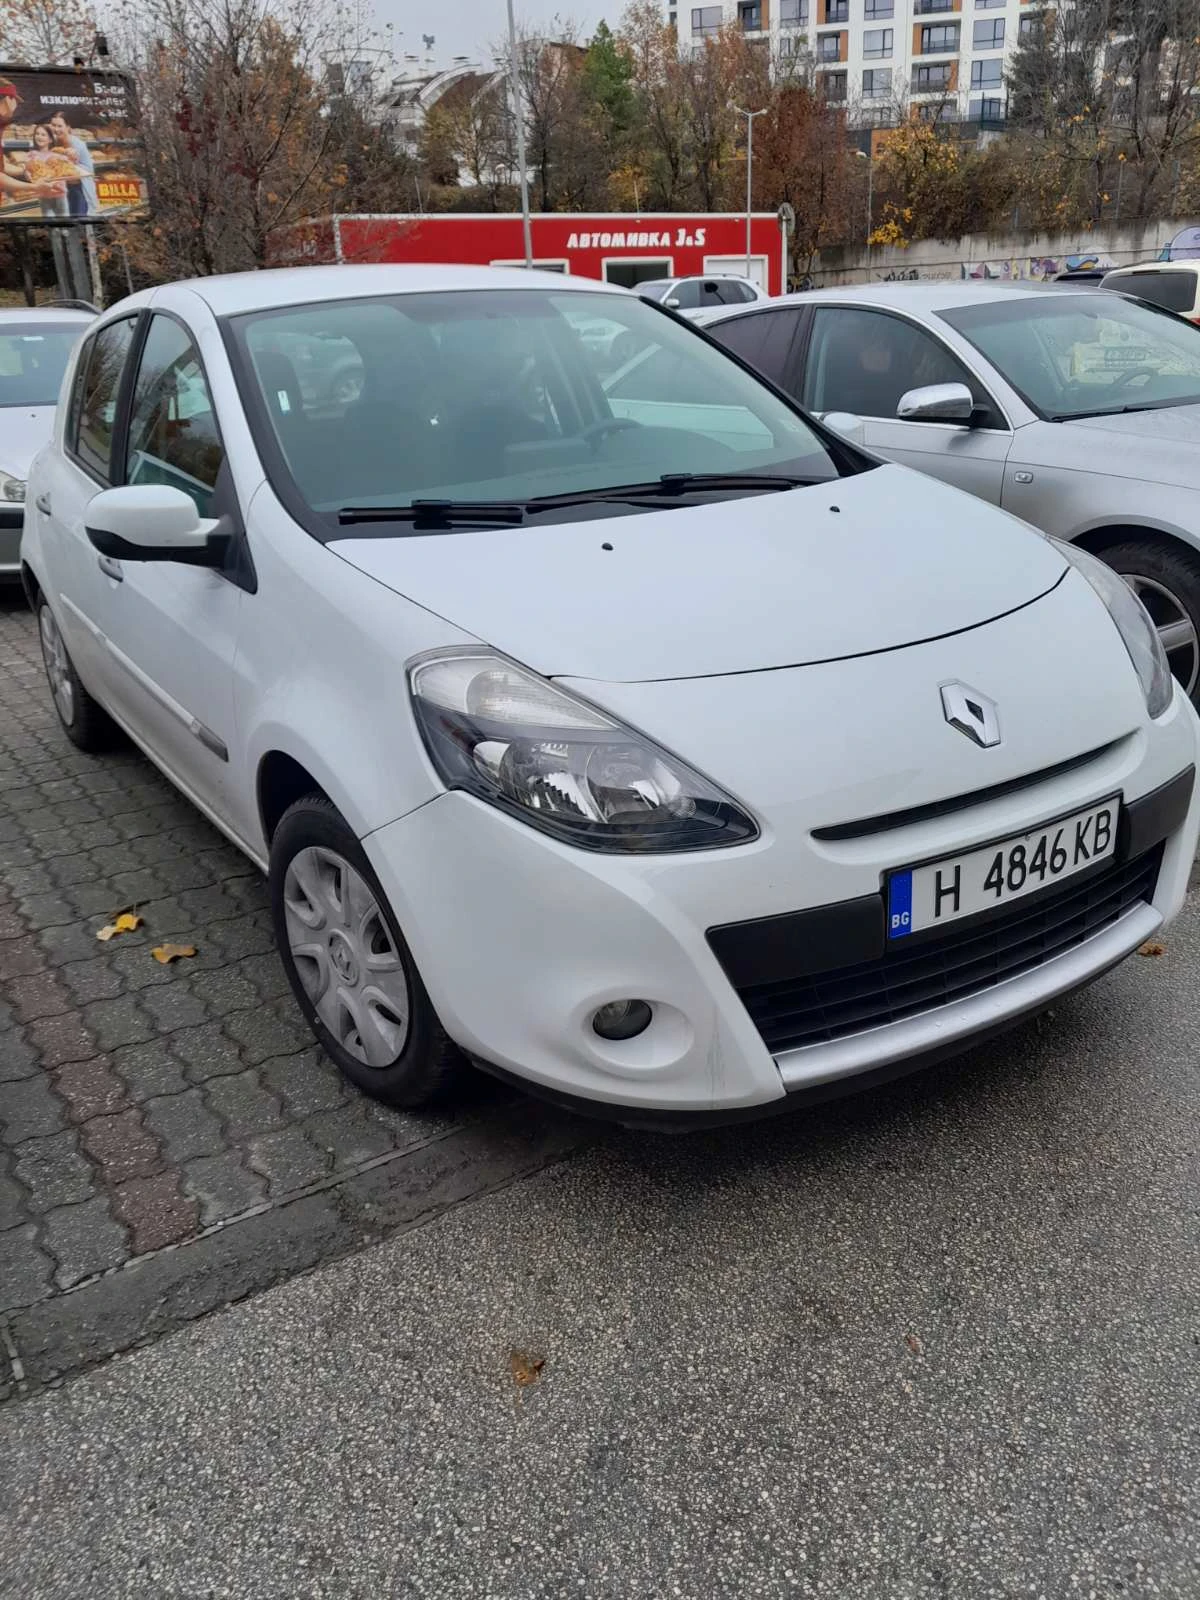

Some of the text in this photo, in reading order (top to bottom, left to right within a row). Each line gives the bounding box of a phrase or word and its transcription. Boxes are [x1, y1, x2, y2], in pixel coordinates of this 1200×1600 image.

[98, 183, 138, 197] BILLA
[567, 232, 670, 248] АВТОМИВКА
[934, 865, 961, 918] H
[891, 911, 910, 929] BG
